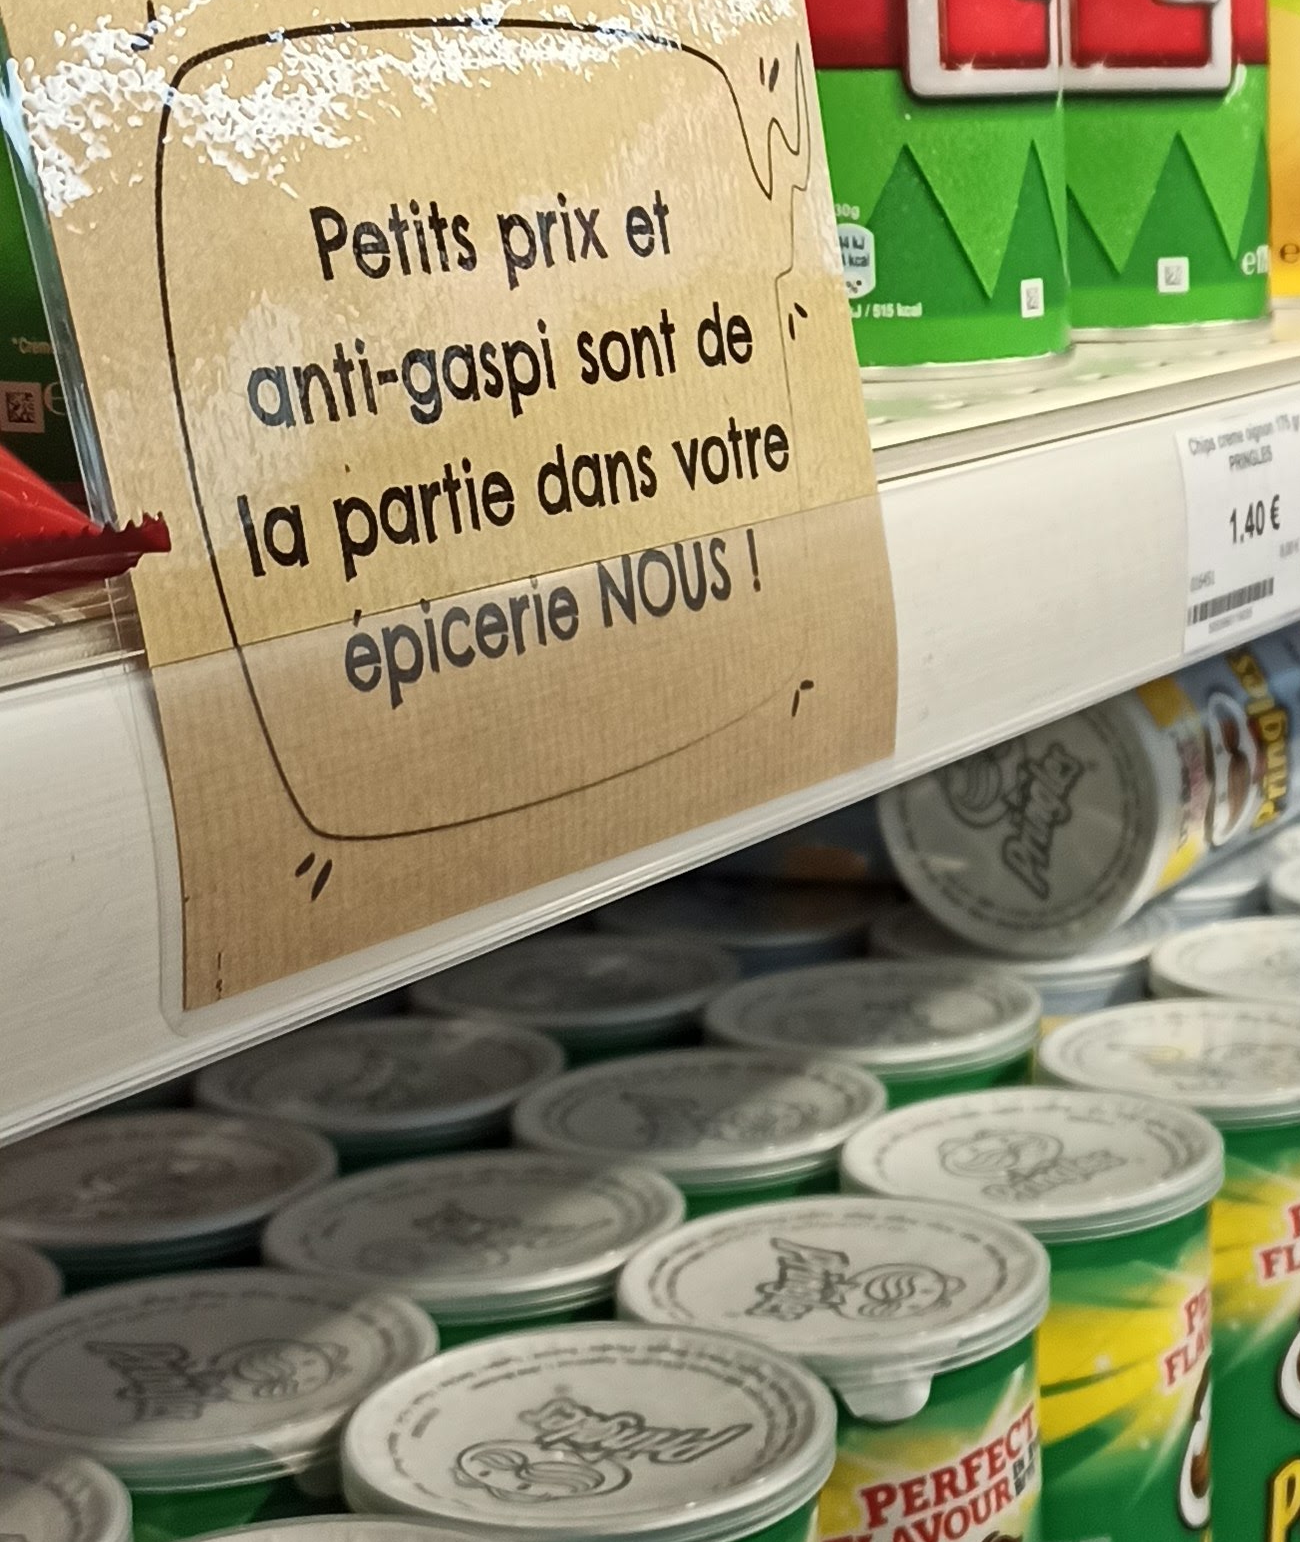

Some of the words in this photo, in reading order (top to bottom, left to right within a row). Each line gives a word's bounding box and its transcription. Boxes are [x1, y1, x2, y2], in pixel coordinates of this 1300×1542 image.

[309, 197, 477, 282] Petits
[496, 192, 608, 290] prix
[625, 190, 671, 259] et
[246, 318, 557, 429] anti-gaspi
[576, 307, 677, 386] sont
[696, 301, 753, 368] de
[237, 493, 310, 579] la
[332, 457, 516, 583] partie
[536, 443, 658, 516] dans
[670, 416, 790, 492] votre
[1228, 444, 1273, 472] PRINGLES
[1270, 494, 1281, 531] €
[344, 573, 580, 711] épicerie
[597, 535, 733, 630] NOUS
[745, 527, 763, 594] !
